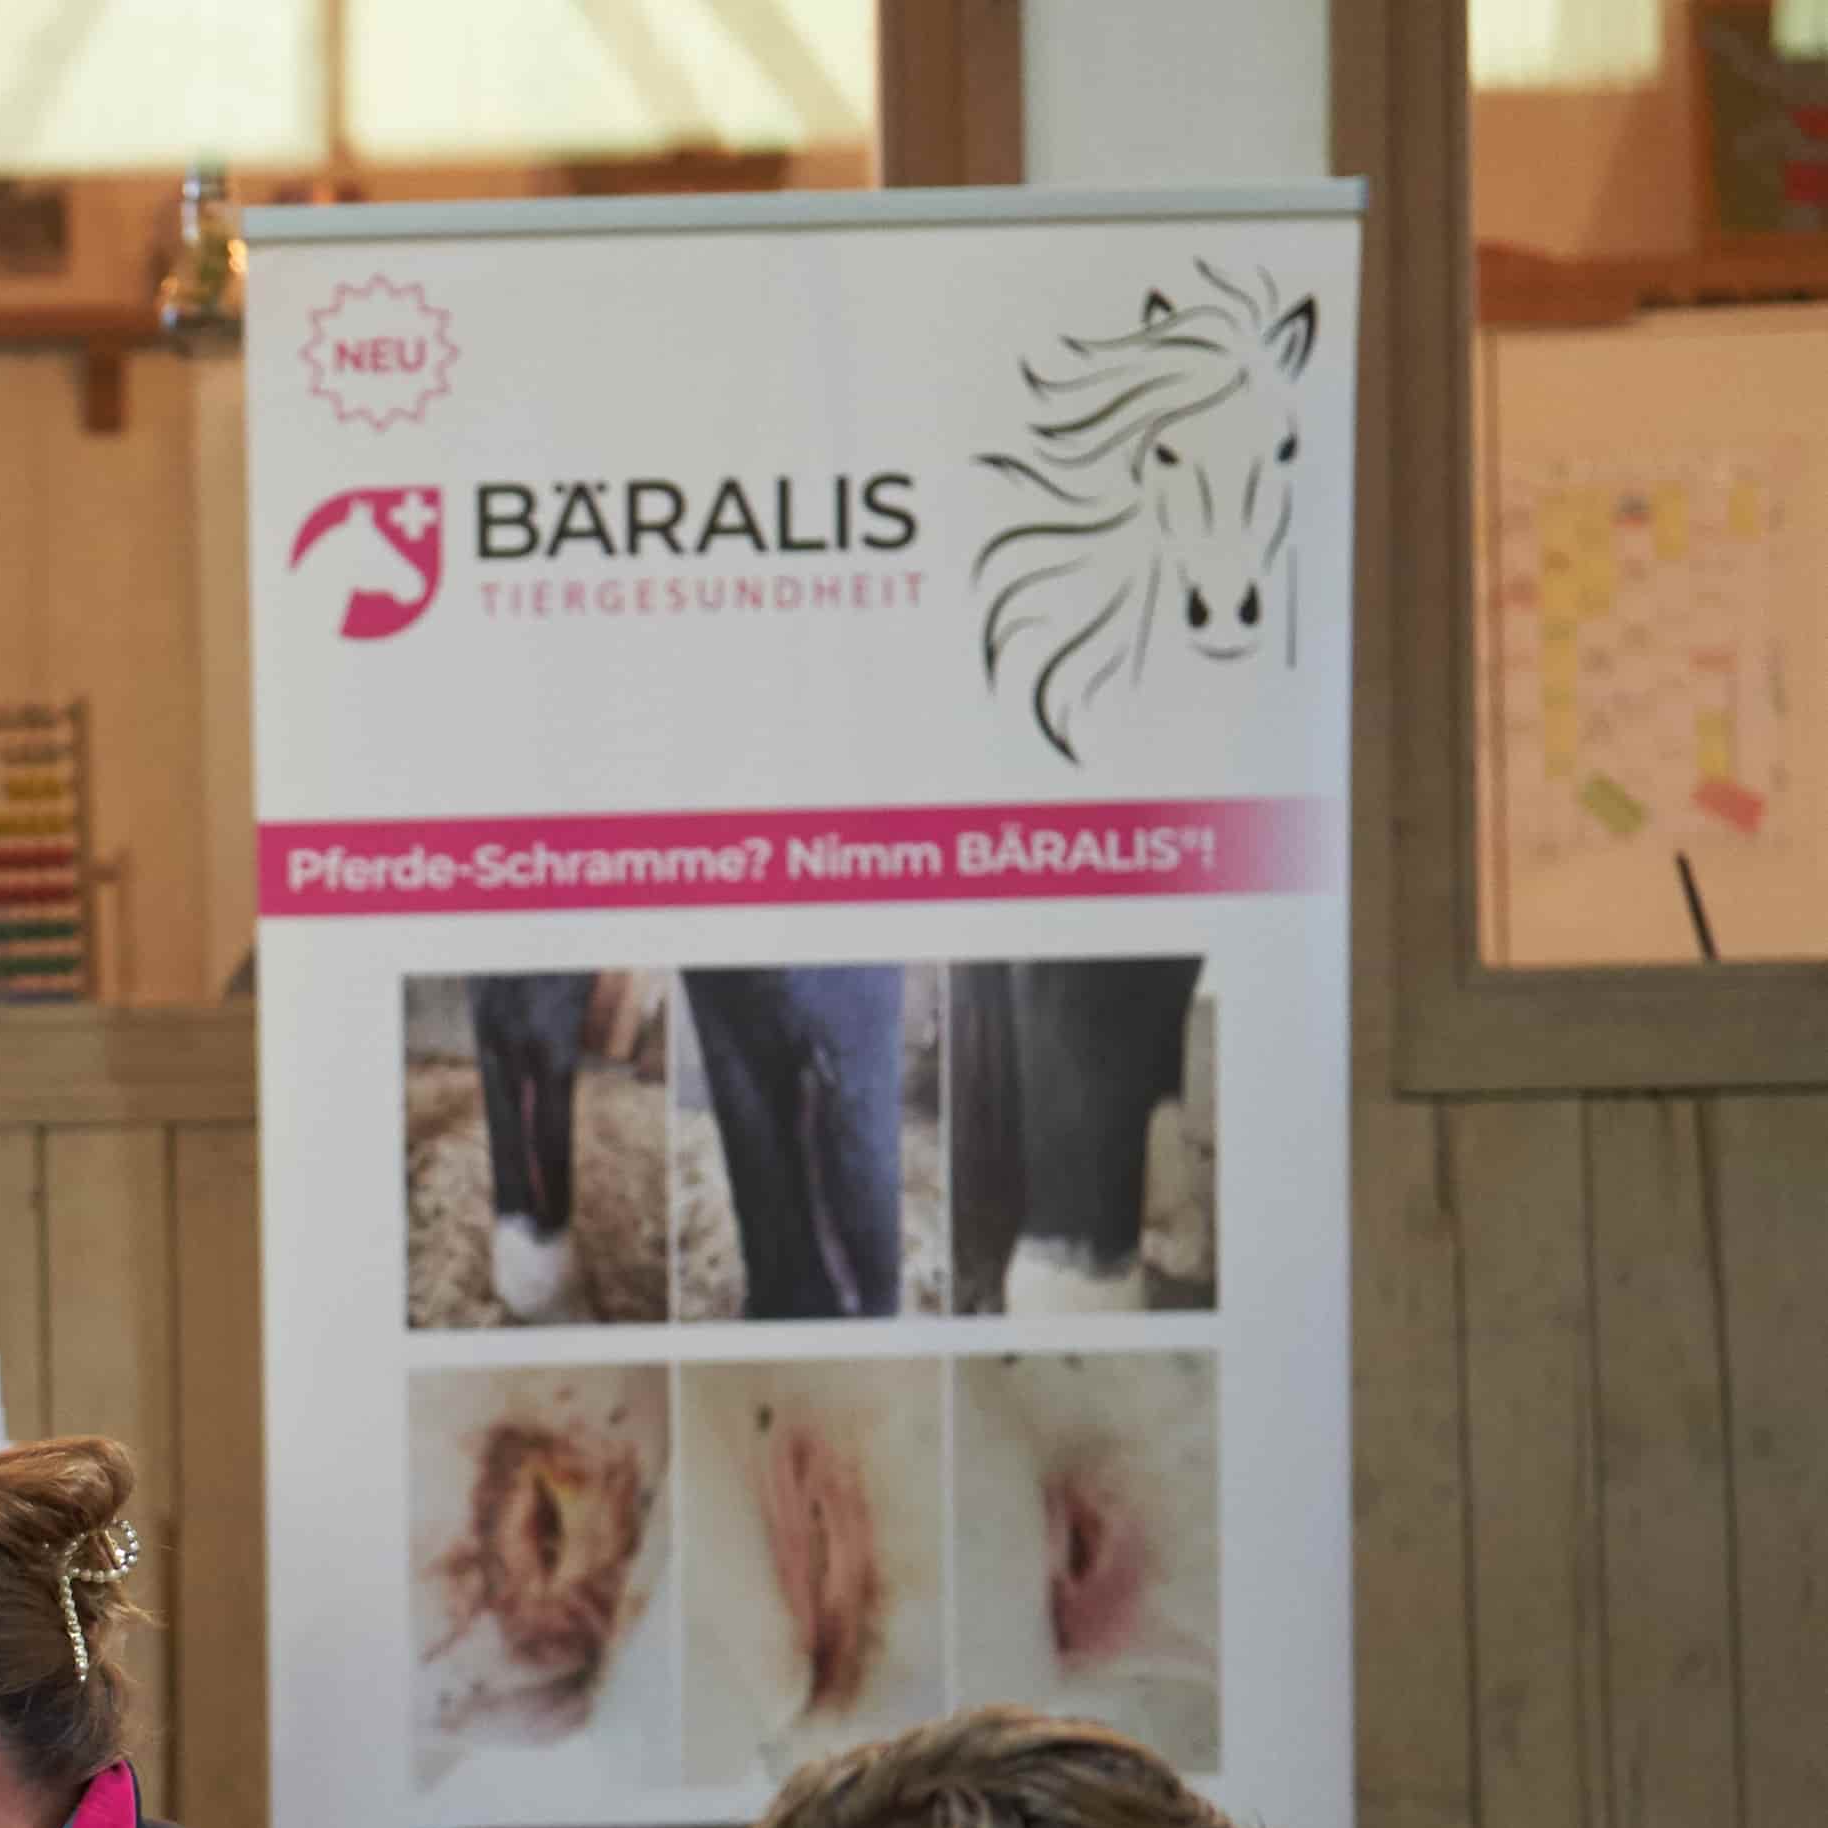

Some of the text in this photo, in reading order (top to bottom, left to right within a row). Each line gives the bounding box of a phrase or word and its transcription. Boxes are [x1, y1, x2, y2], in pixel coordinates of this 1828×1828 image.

[332, 338, 426, 373] NEU
[476, 473, 919, 559] BÄRALIS
[479, 573, 926, 616] TIERGESUNDHEIT
[286, 836, 772, 894] Pferde-Schramme?
[787, 831, 942, 882] Nimm
